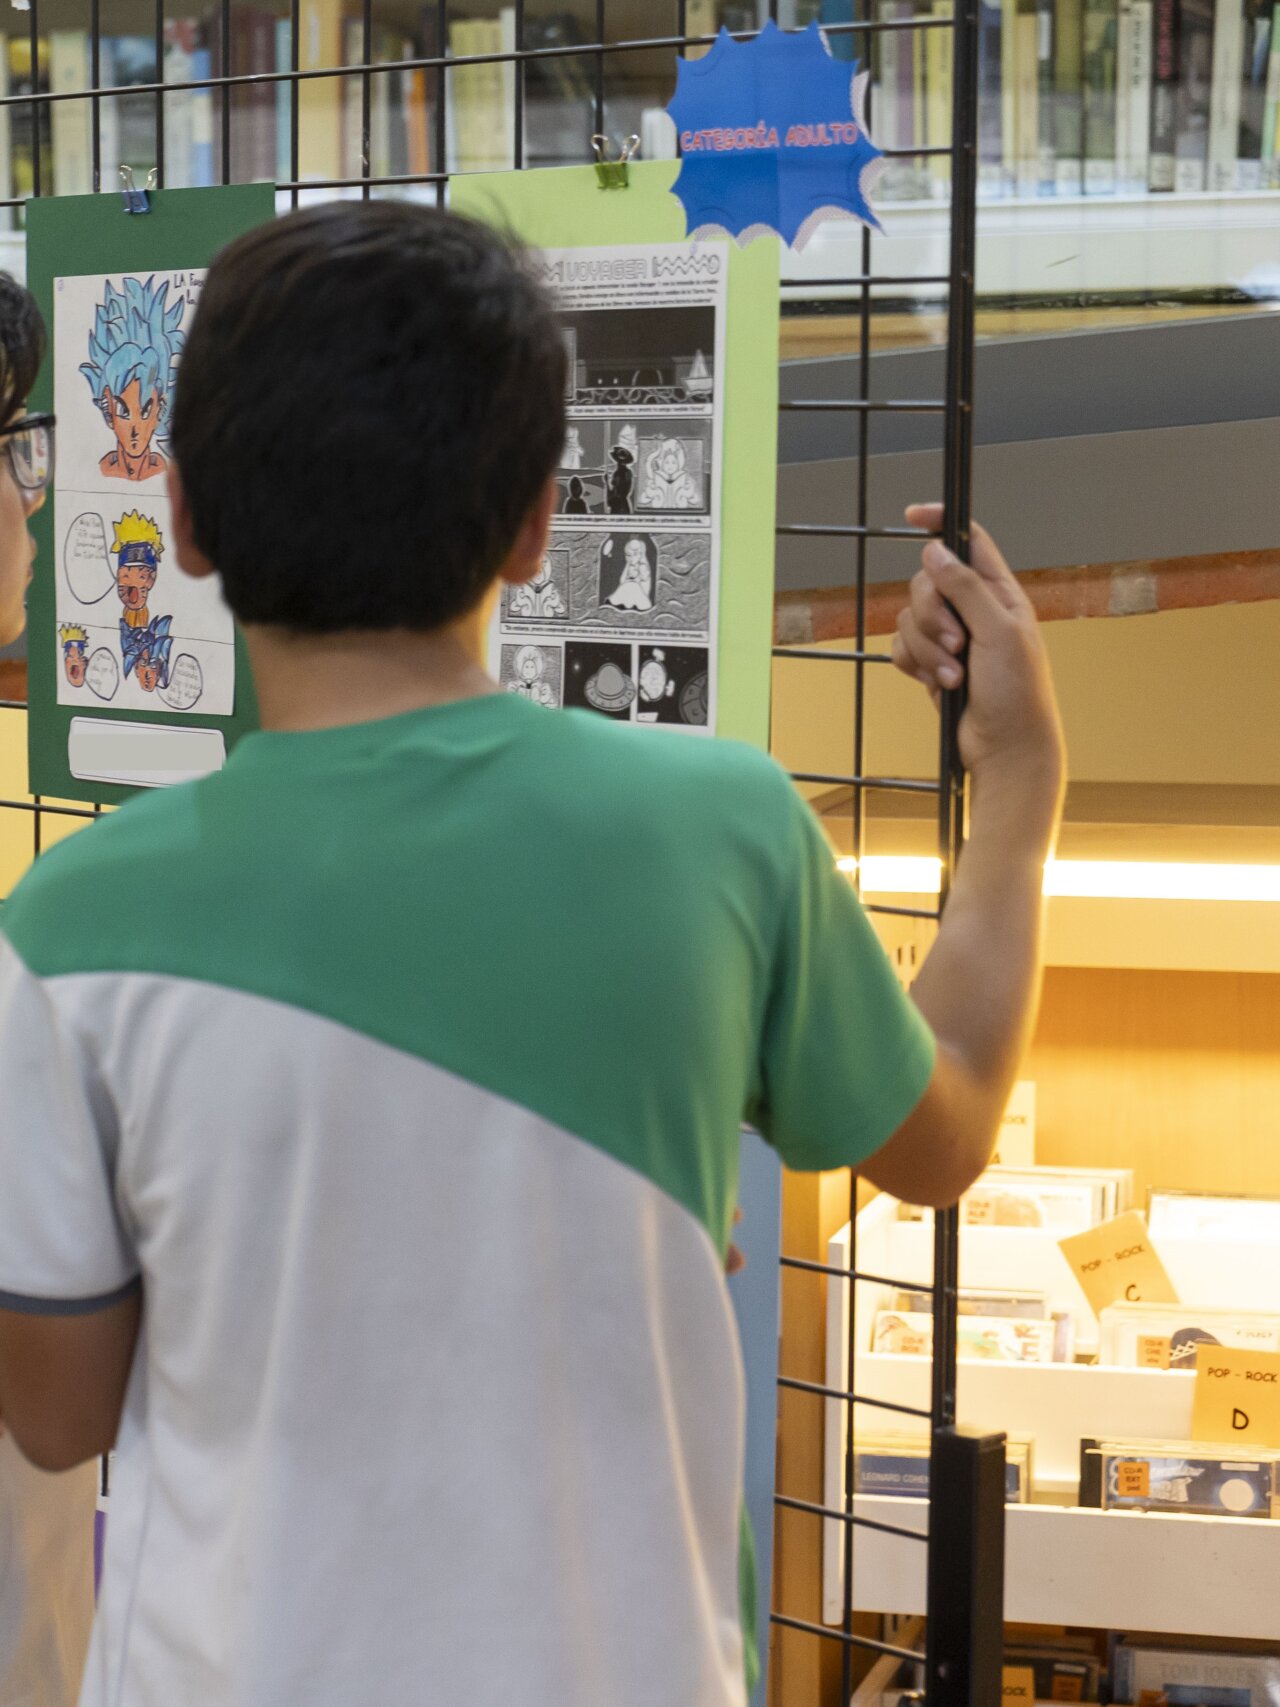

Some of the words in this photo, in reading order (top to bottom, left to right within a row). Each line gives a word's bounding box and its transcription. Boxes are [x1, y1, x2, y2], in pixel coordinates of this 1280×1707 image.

[680, 118, 779, 152] CATEGORÍA
[785, 121, 859, 147] ADULTO
[1001, 1115, 1026, 1126] OCK
[1081, 1259, 1101, 1273] POP
[1114, 1245, 1145, 1261] ROCK
[1208, 1367, 1230, 1378] POP
[1246, 1371, 1277, 1383] ROCK
[1232, 1408, 1249, 1430] D
[862, 1471, 901, 1483] LEONARD
[1003, 1685, 1027, 1697] OCK
